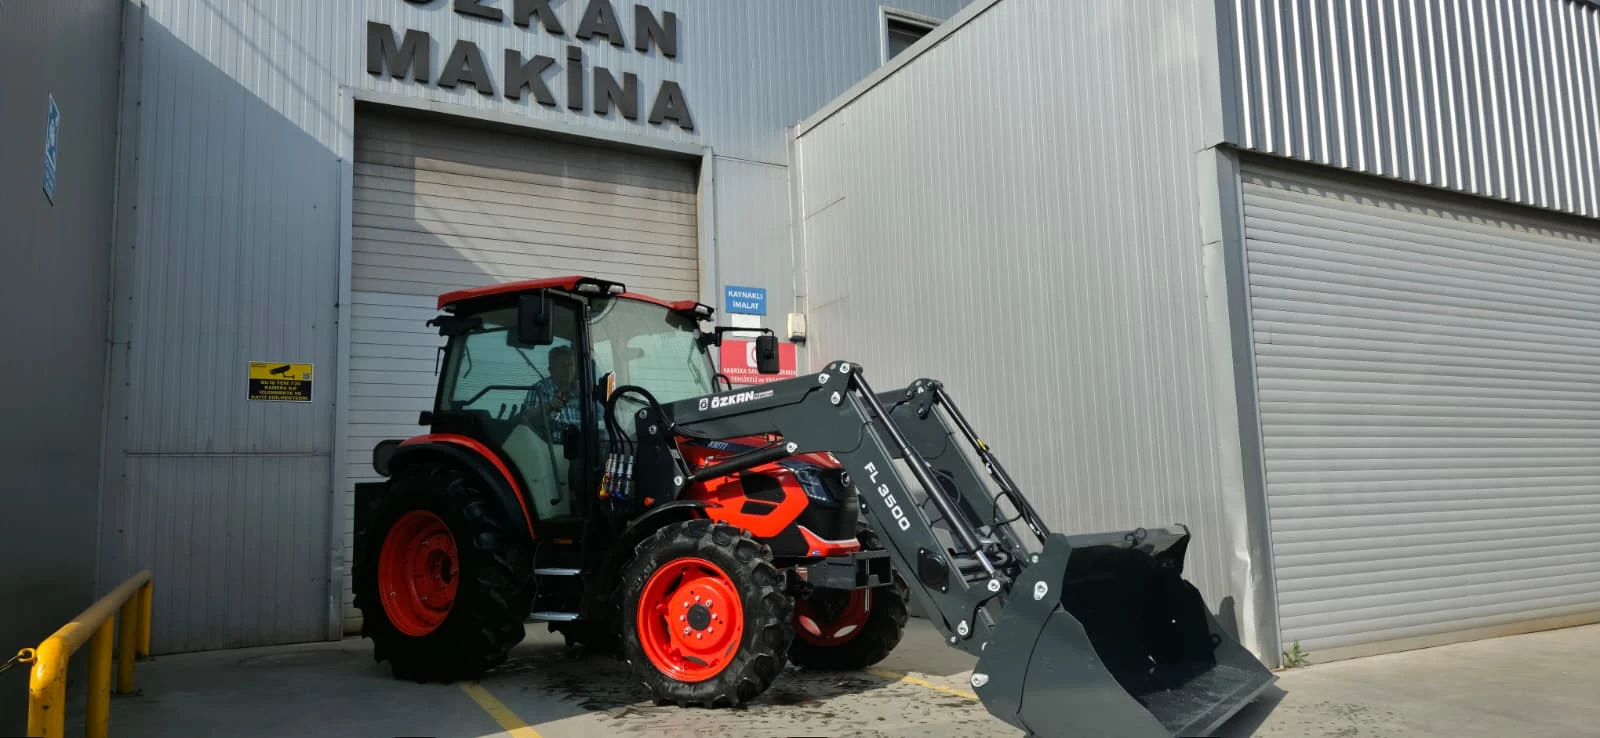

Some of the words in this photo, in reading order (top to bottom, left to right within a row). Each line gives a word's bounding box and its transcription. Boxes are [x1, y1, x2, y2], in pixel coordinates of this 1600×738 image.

[405, 0, 677, 58] KAN
[367, 20, 694, 131] MAKİNA
[728, 290, 763, 300] KAYNAKLI
[711, 390, 754, 408] ÖZKAN
[864, 461, 879, 484] FL
[877, 483, 911, 531] 3500
